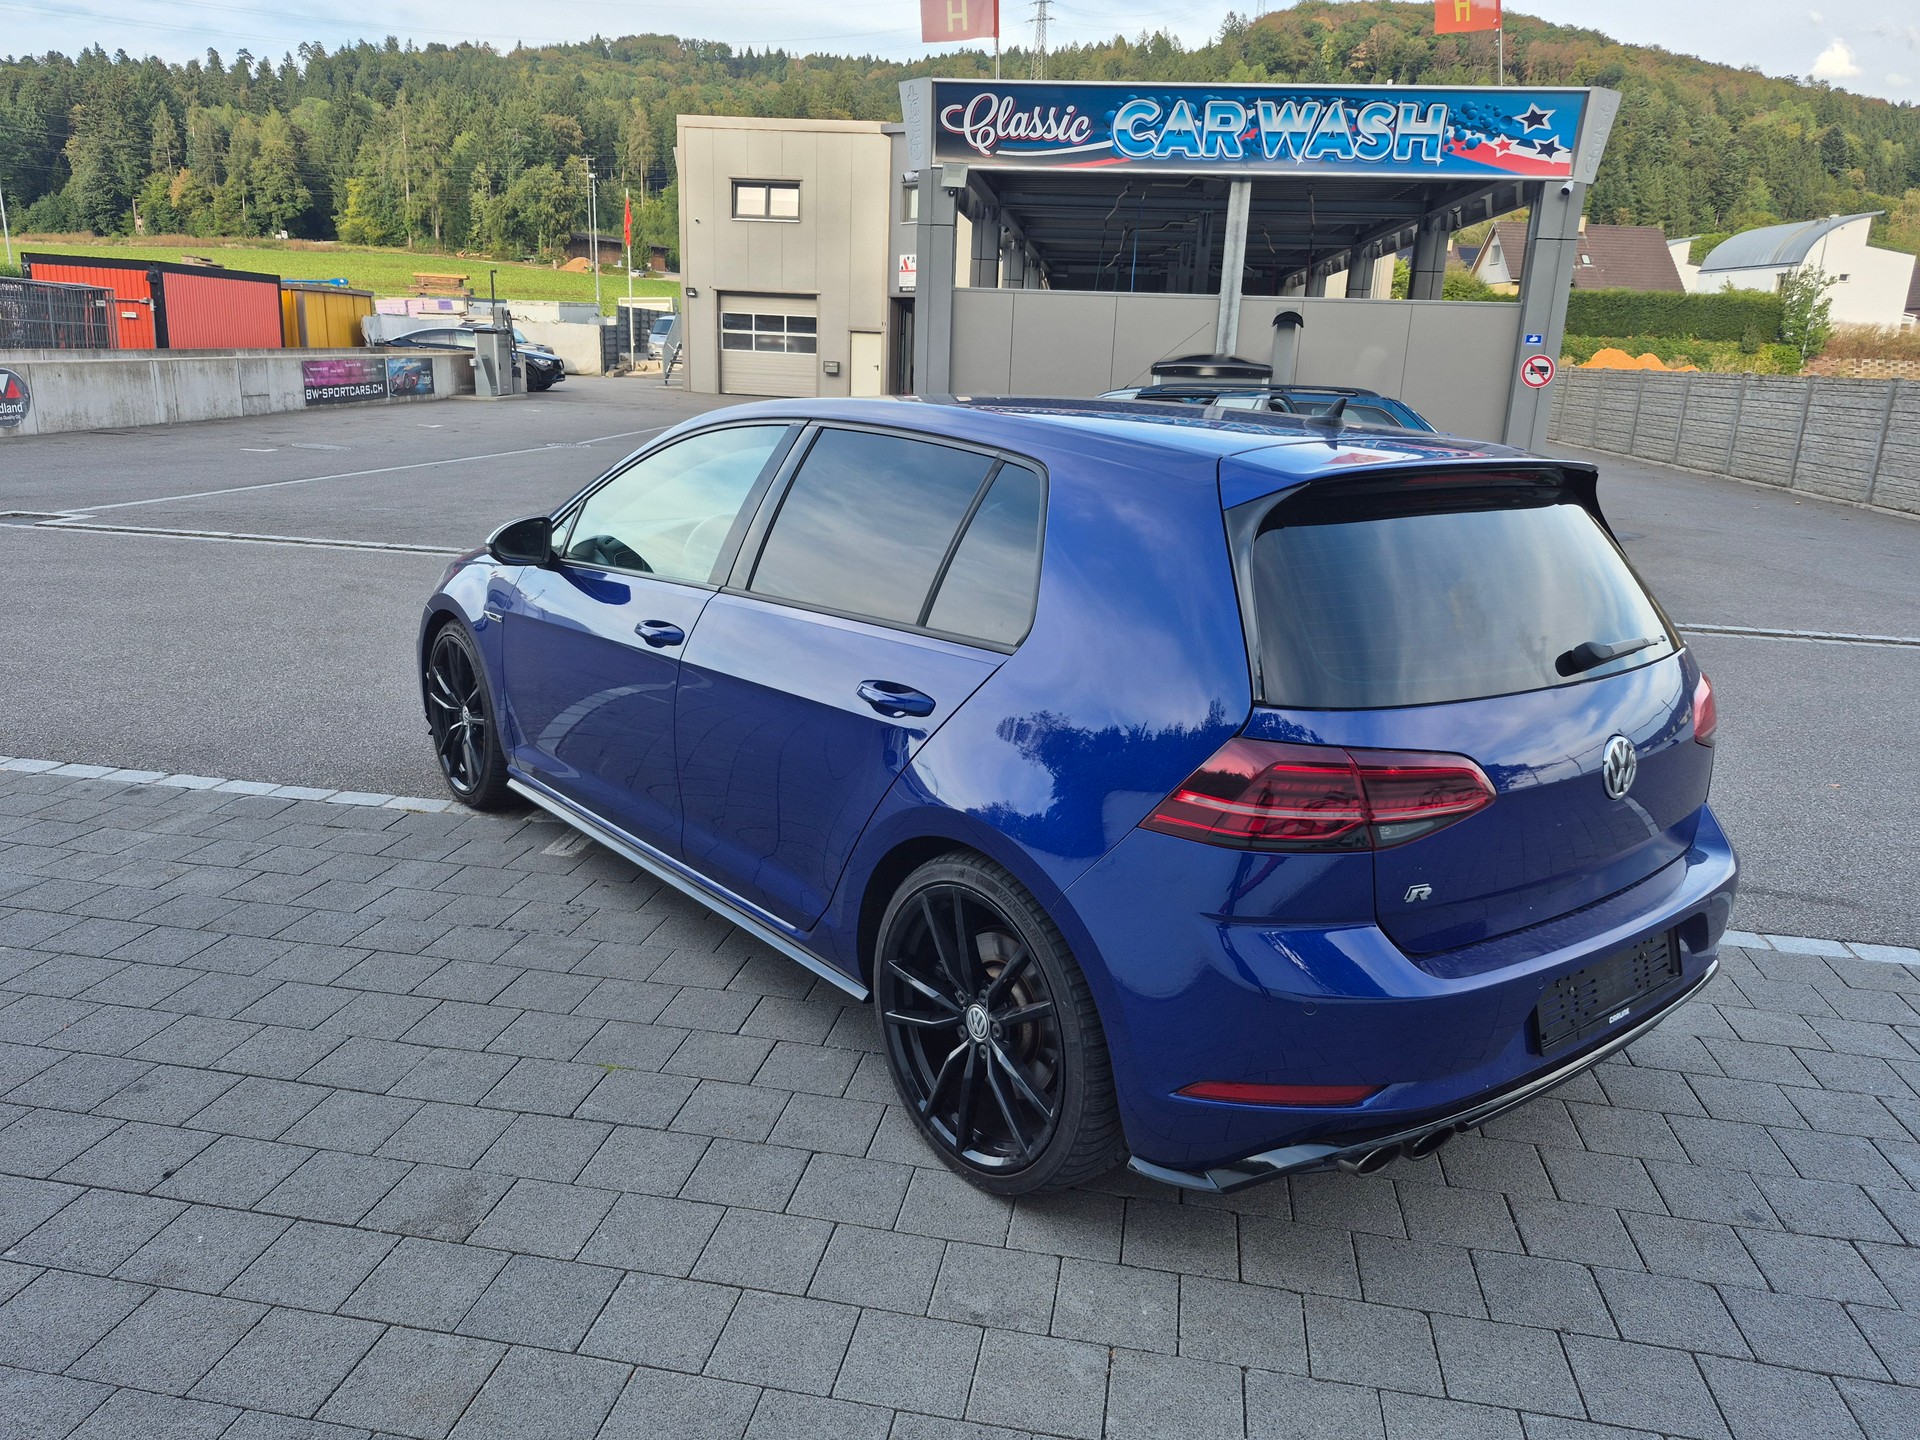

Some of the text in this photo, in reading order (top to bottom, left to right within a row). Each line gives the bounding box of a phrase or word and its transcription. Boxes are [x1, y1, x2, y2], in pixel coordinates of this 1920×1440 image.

[940, 93, 1449, 163] Classic CAR WASH
[305, 383, 384, 400] BW-SPORTCARS.CH
[1404, 883, 1432, 902] R
